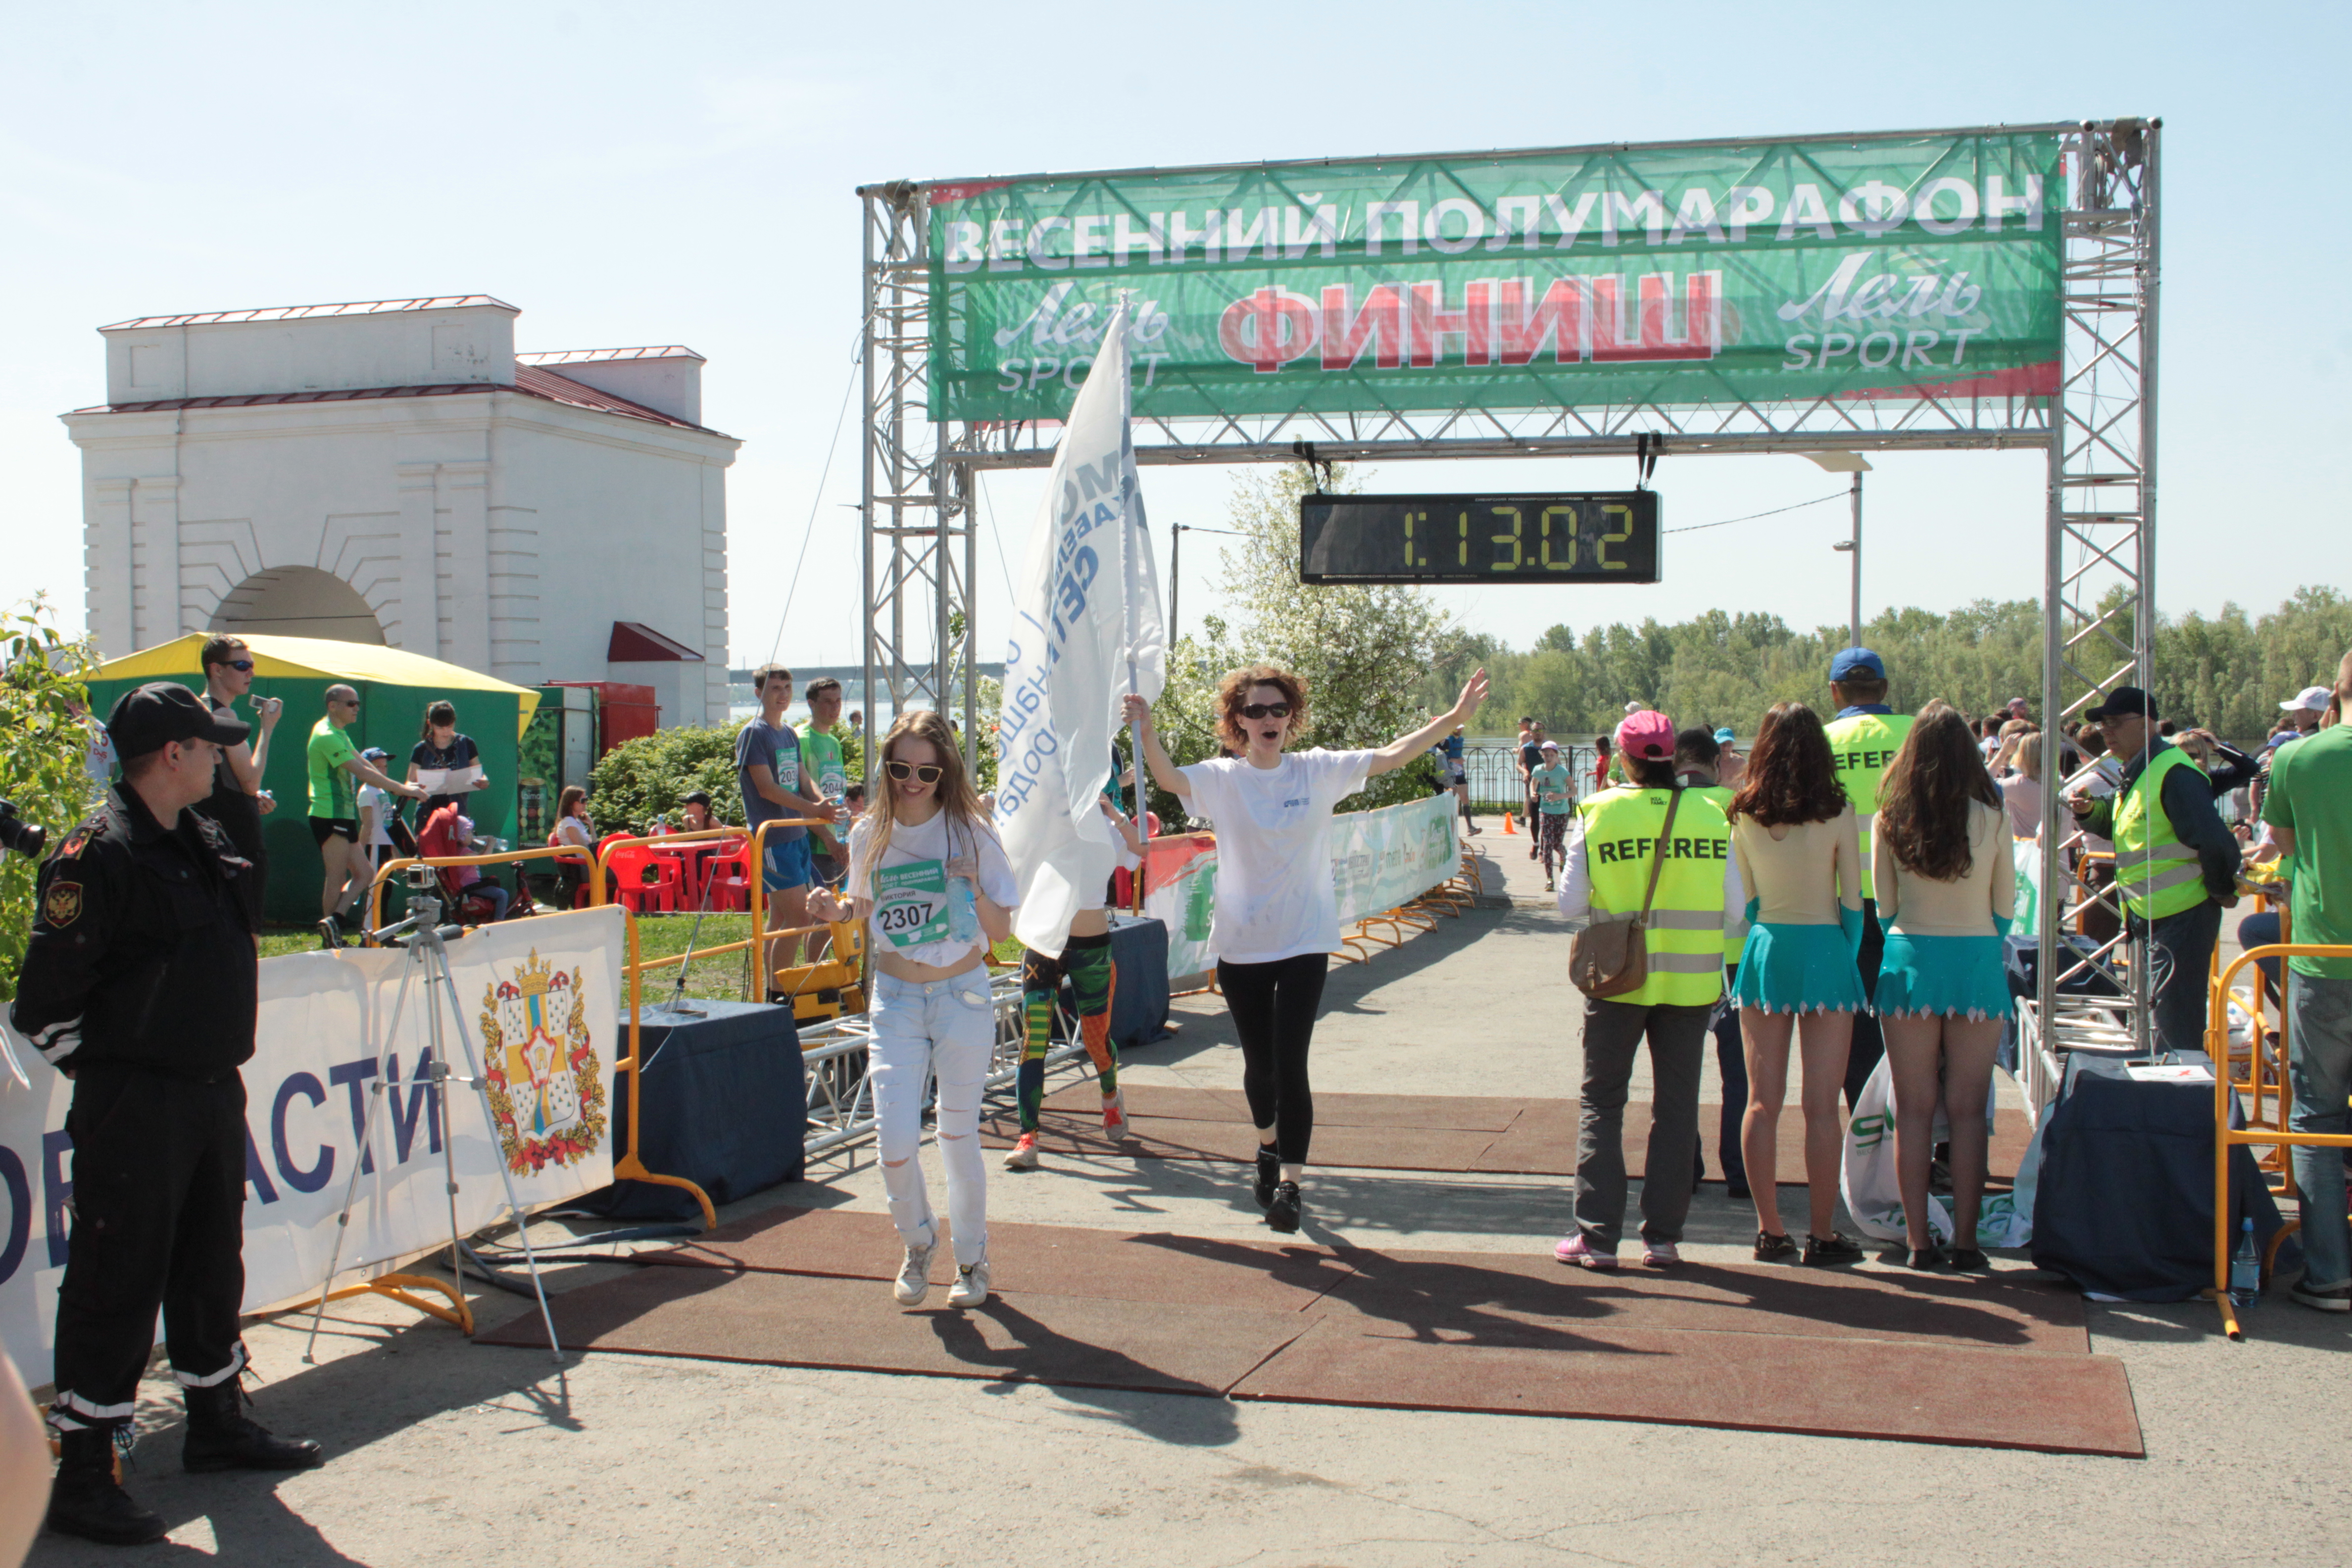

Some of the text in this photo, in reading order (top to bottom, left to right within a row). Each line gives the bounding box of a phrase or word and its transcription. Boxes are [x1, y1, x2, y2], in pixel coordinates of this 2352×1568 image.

[943, 173, 2044, 275] ВЕСЕННИЙ ПОЛУМАРАФОН
[1777, 251, 1982, 322] Лель
[1218, 269, 1721, 374] ФИНИШ
[1782, 328, 1982, 370] SPORT
[997, 352, 1170, 392] SPOT
[1833, 750, 1898, 770] EFER
[1598, 838, 1727, 864] REFEREE
[900, 867, 939, 881] ВЕСЕННИЙ
[880, 903, 933, 931] 2307
